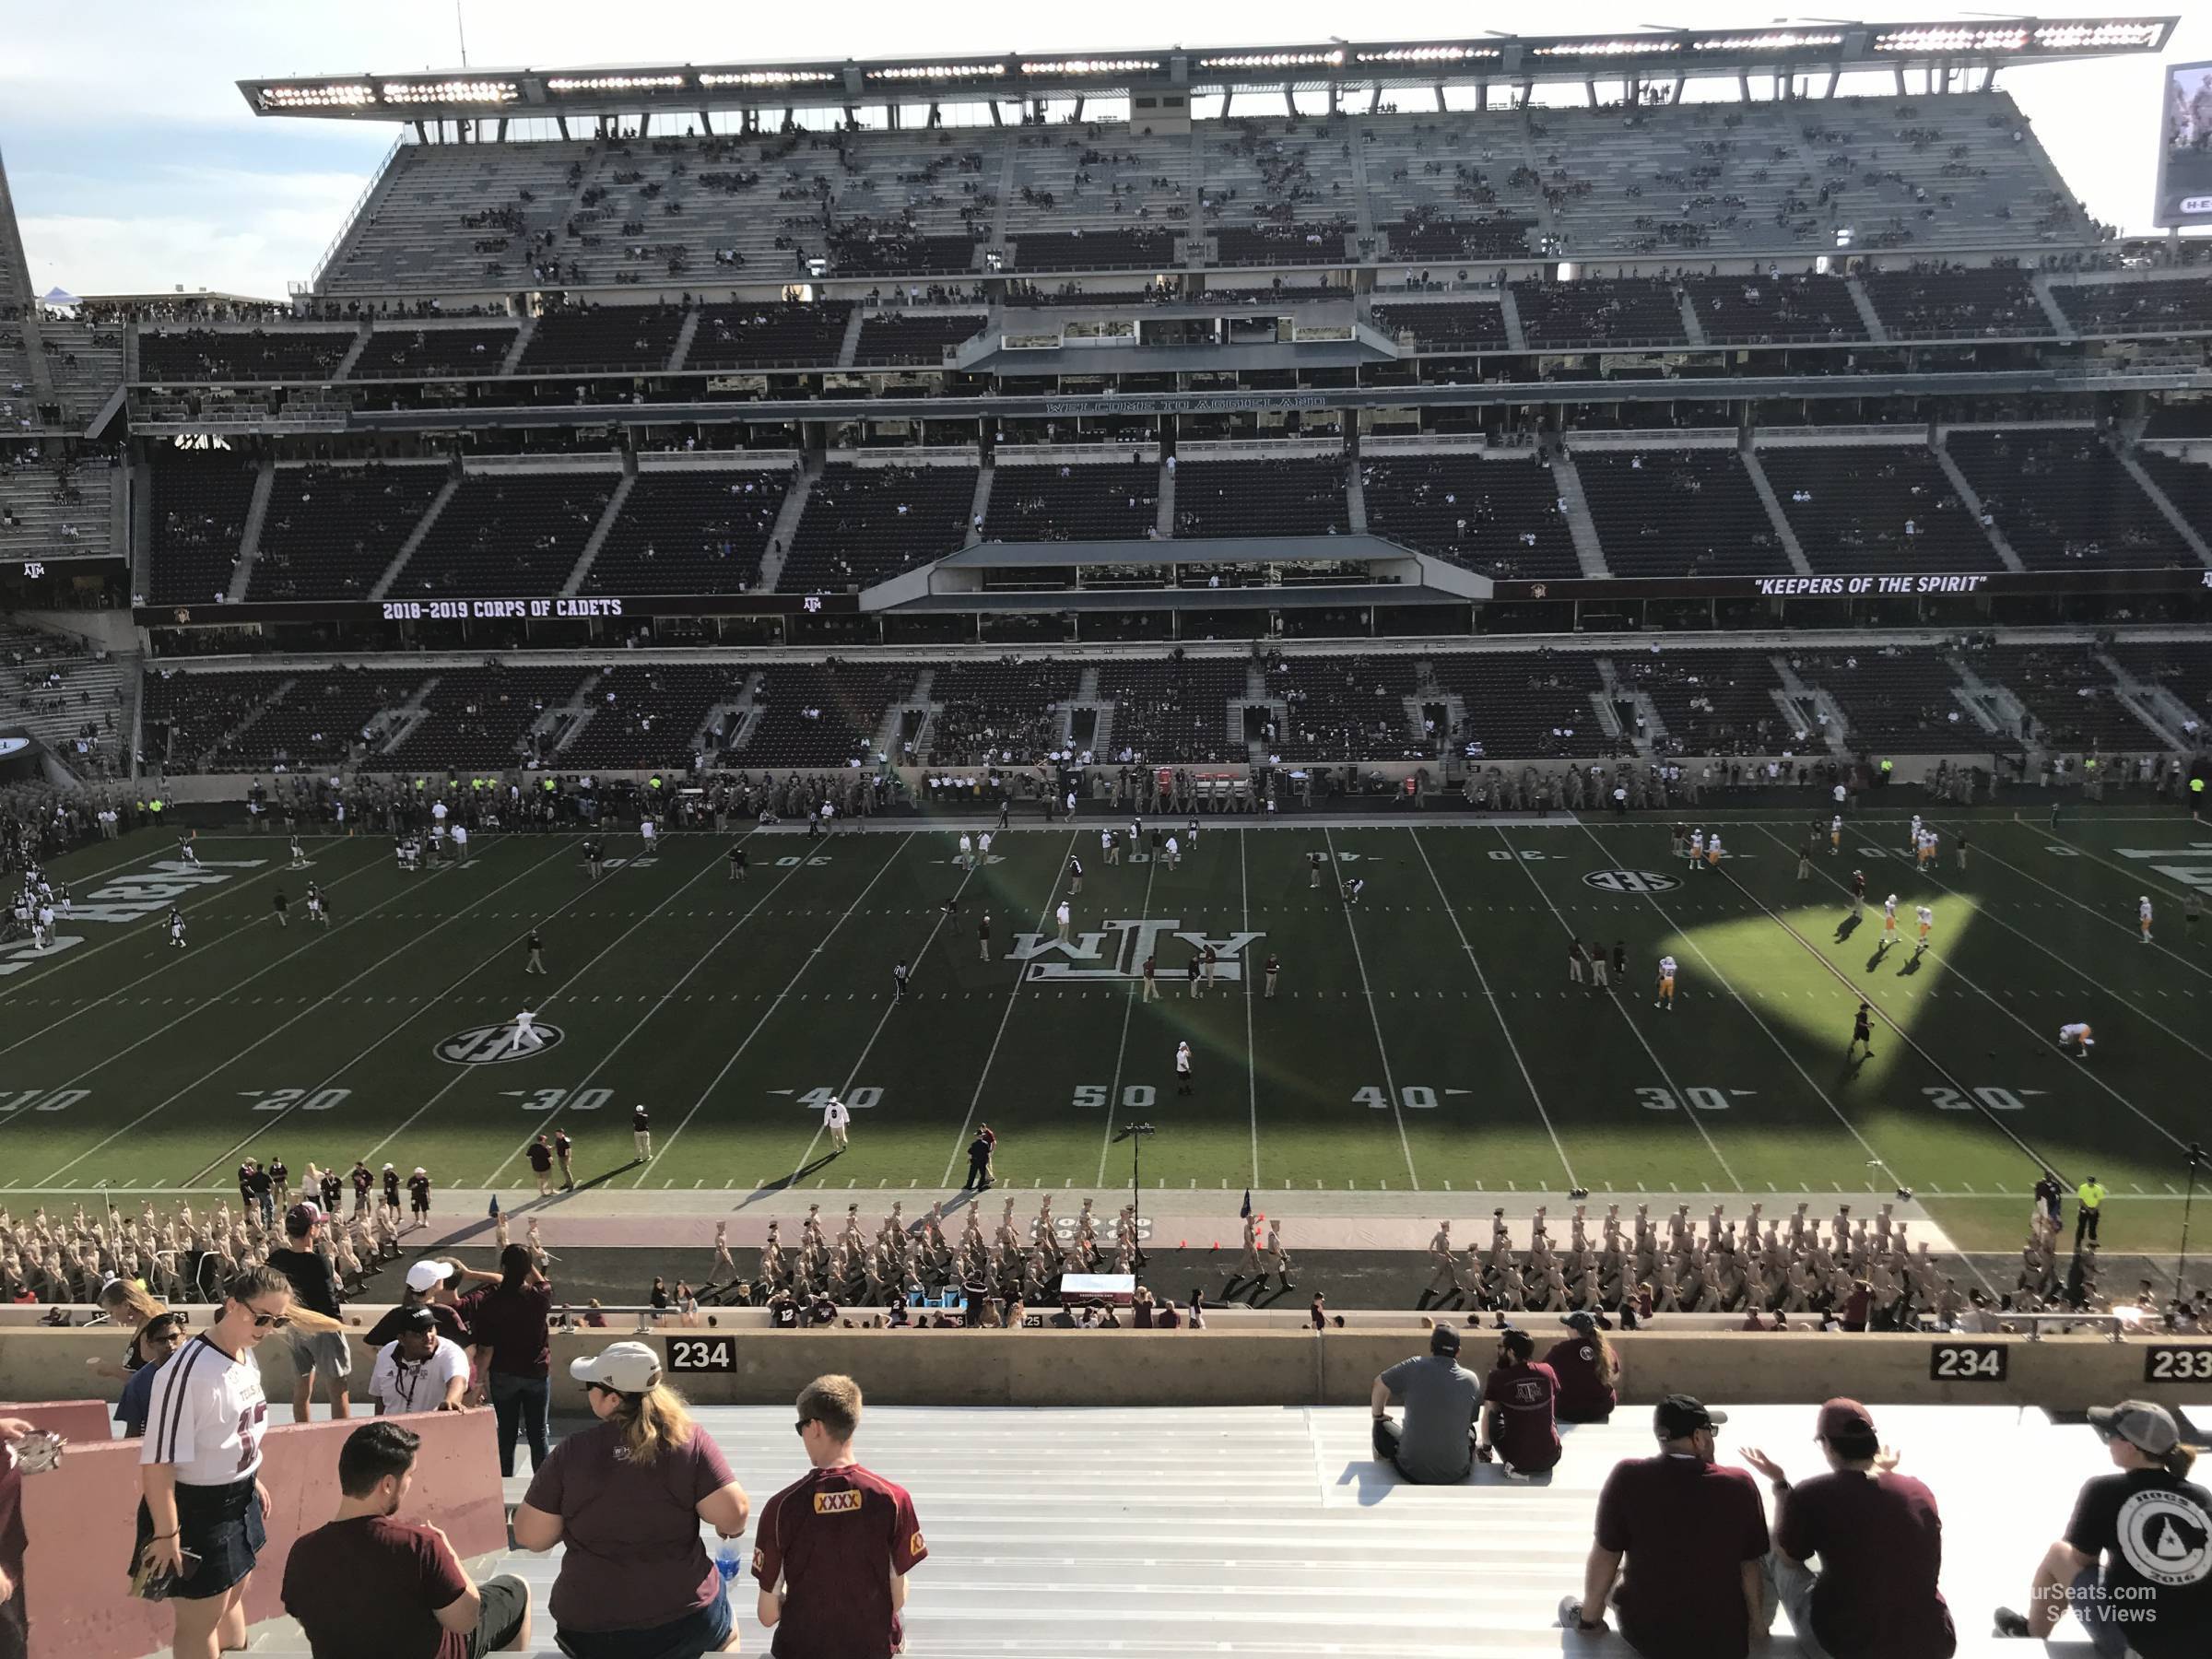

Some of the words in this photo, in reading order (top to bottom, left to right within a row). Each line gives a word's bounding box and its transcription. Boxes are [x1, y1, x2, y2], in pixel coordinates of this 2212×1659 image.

[1046, 402, 1151, 414] WELCOME
[1161, 400, 1189, 410] TO
[1196, 396, 1325, 410] AGGIELAND
[1755, 578, 1843, 594] "KEEPERS
[1848, 577, 1873, 594] OF
[1877, 577, 1912, 593] THE
[1916, 576, 1987, 593] SPIRIT"
[383, 602, 468, 619] 2018-2019
[474, 601, 525, 617] CORPS
[531, 600, 550, 616] OF
[556, 599, 622, 616] CADETS
[1592, 871, 1676, 891] SEC
[252, 1088, 352, 1110] 20
[522, 1088, 614, 1110] 30
[796, 1087, 884, 1109] 40
[1072, 1085, 1157, 1107] 50
[1351, 1086, 1438, 1108] 40
[1634, 1088, 1729, 1109] 30
[1921, 1088, 2025, 1109] 20
[781, 1309, 794, 1321] 12
[673, 1342, 729, 1367] 234
[1937, 1349, 1999, 1376] 234
[2153, 1351, 2212, 1378] 233
[818, 1494, 859, 1511] XXXX
[2147, 1571, 2195, 1583] 2016
